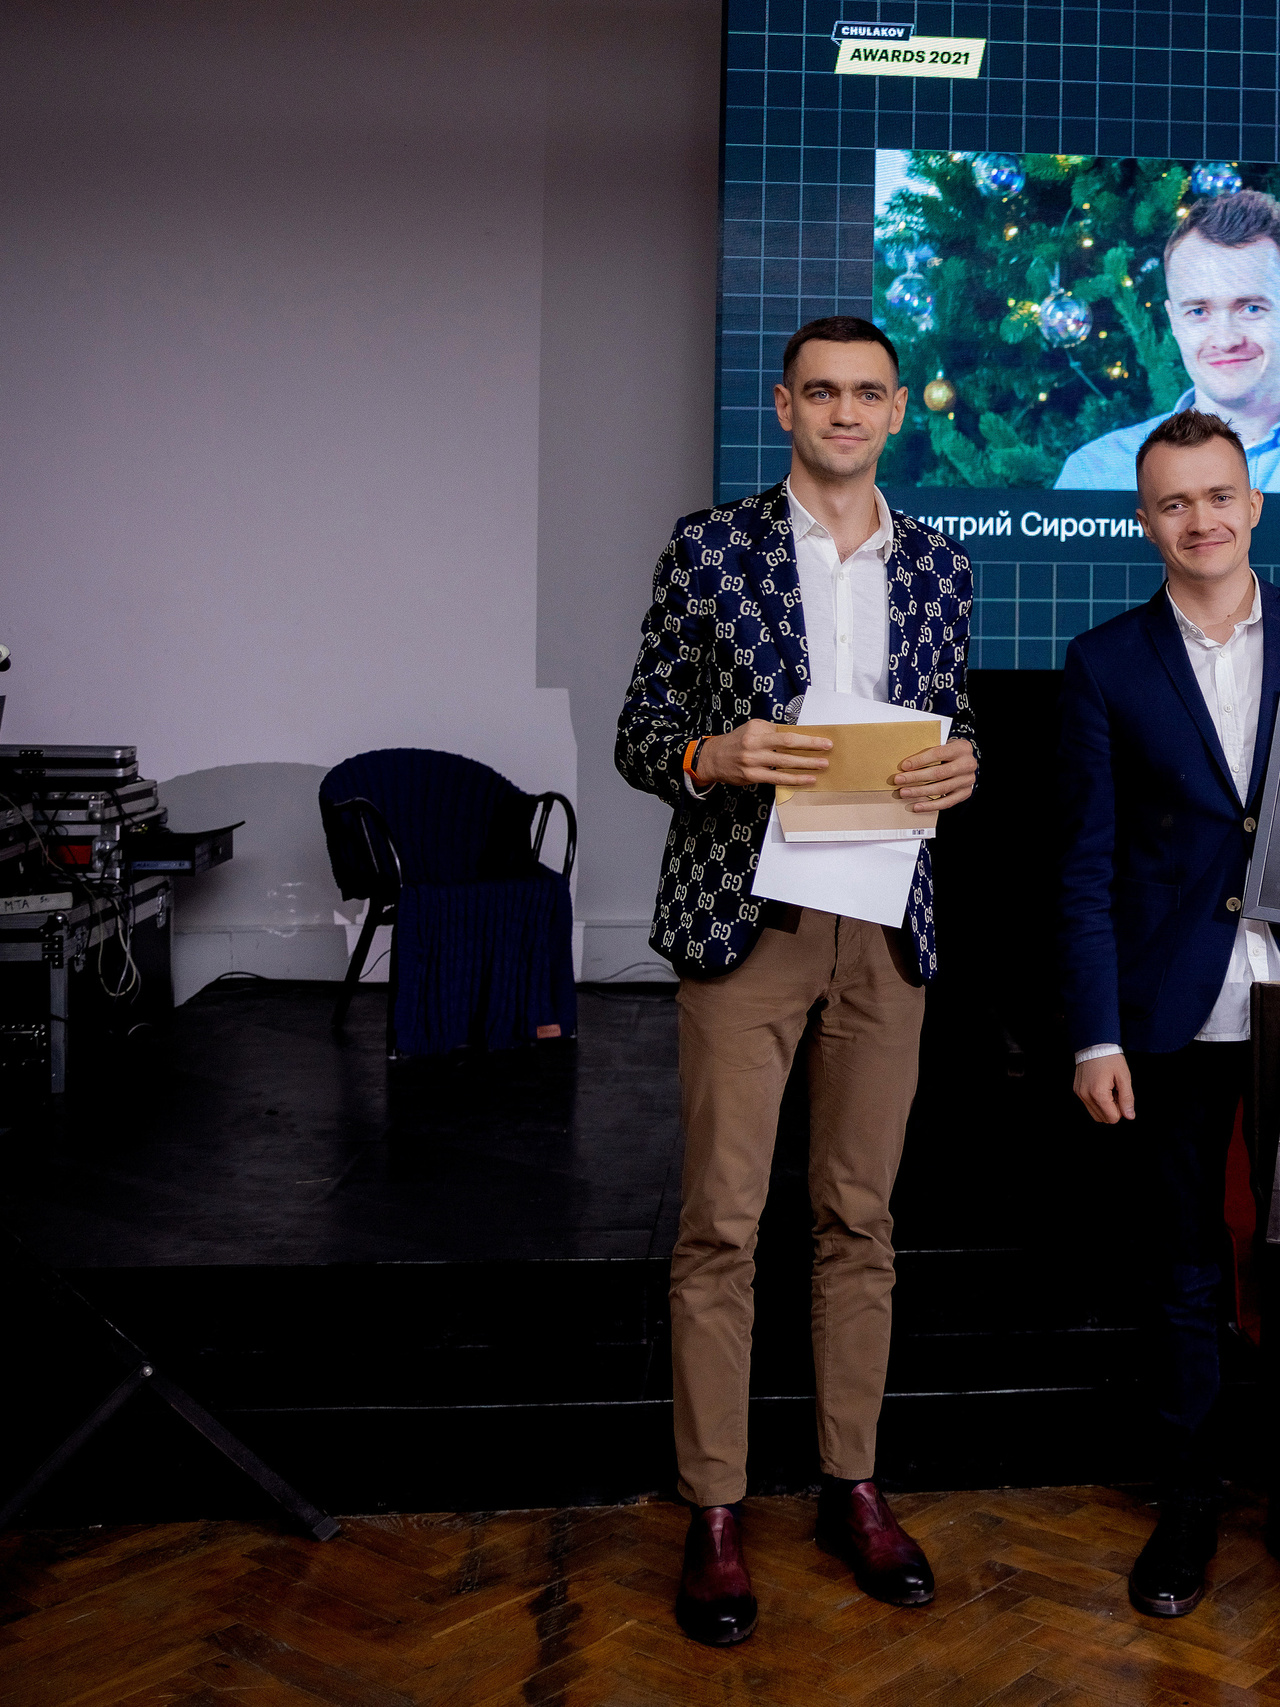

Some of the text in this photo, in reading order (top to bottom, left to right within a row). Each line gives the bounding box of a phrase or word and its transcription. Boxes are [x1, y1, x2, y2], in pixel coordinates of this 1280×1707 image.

[841, 26, 905, 38] CHULAKOV
[850, 48, 970, 65] AWARDS 2021
[1020, 511, 1144, 542] Сиротин
